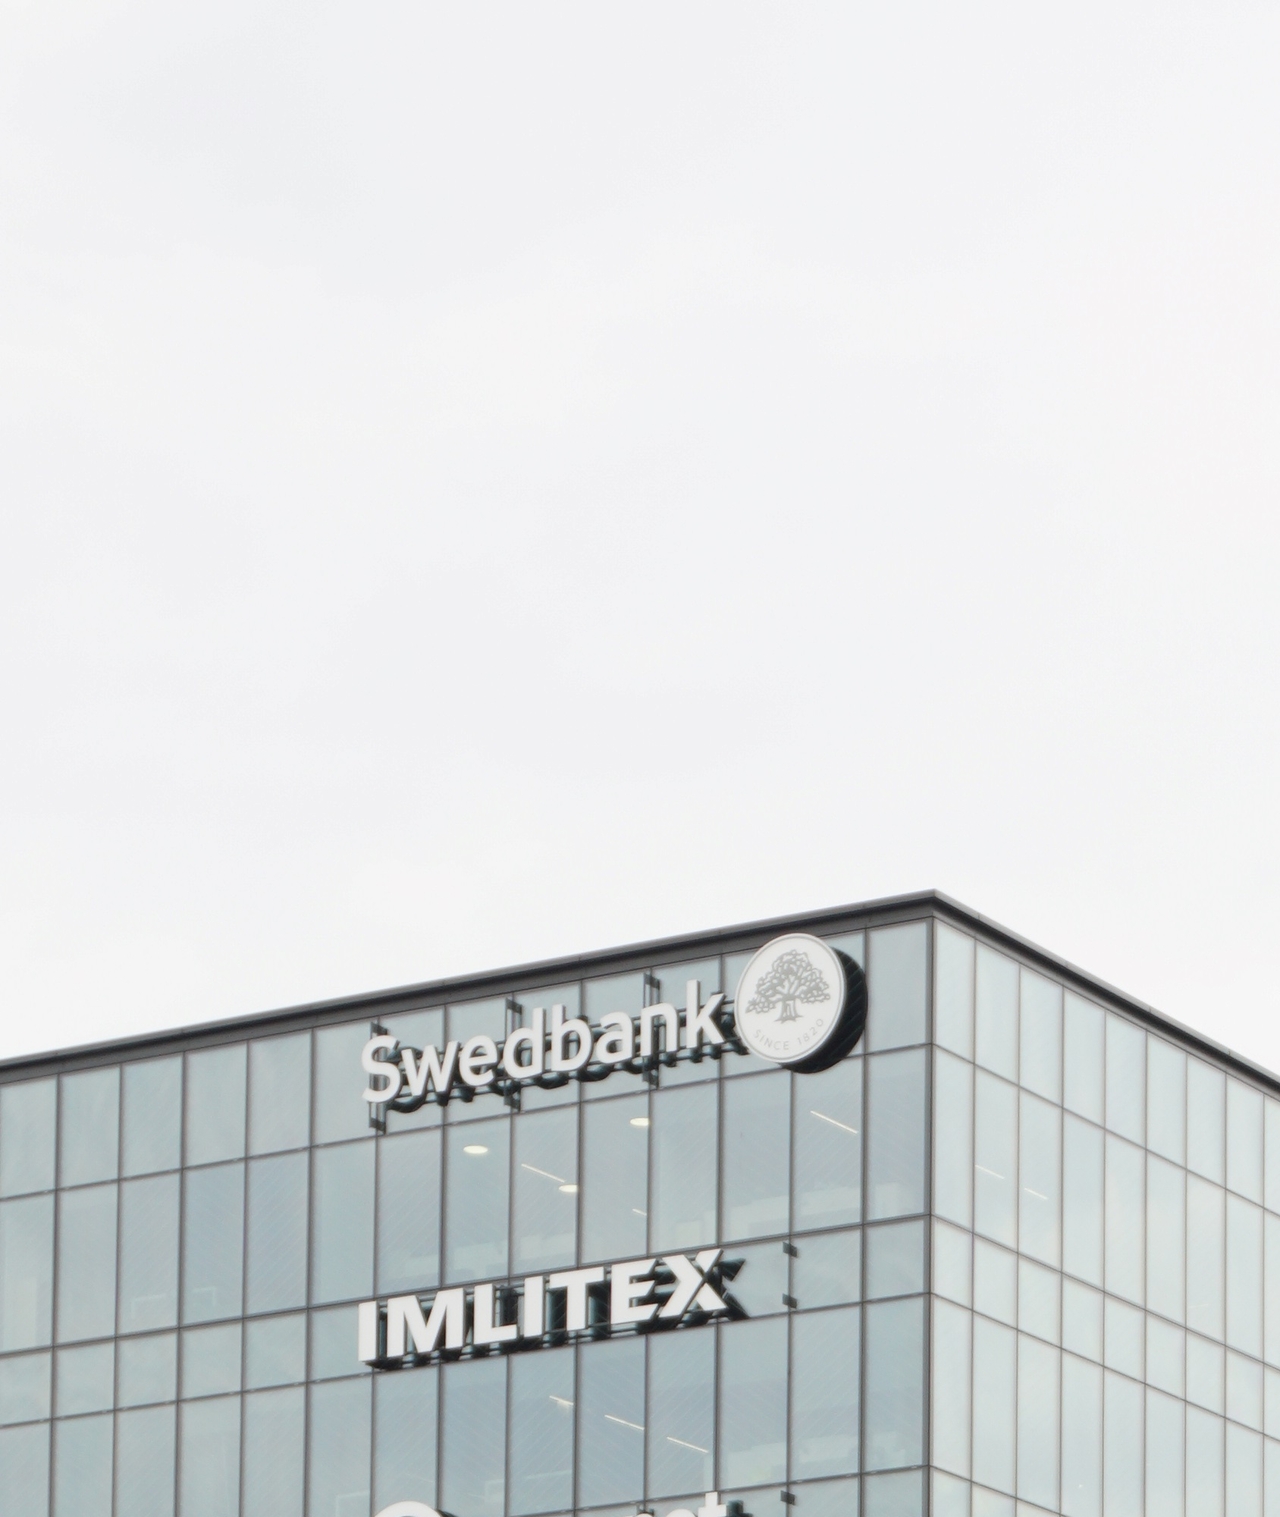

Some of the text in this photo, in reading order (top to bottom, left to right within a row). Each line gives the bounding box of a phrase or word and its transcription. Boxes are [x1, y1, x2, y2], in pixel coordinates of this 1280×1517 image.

[361, 979, 726, 1104] Swedbank
[753, 1018, 824, 1051] SINCE 1820
[358, 1248, 726, 1363] IMLITEX
